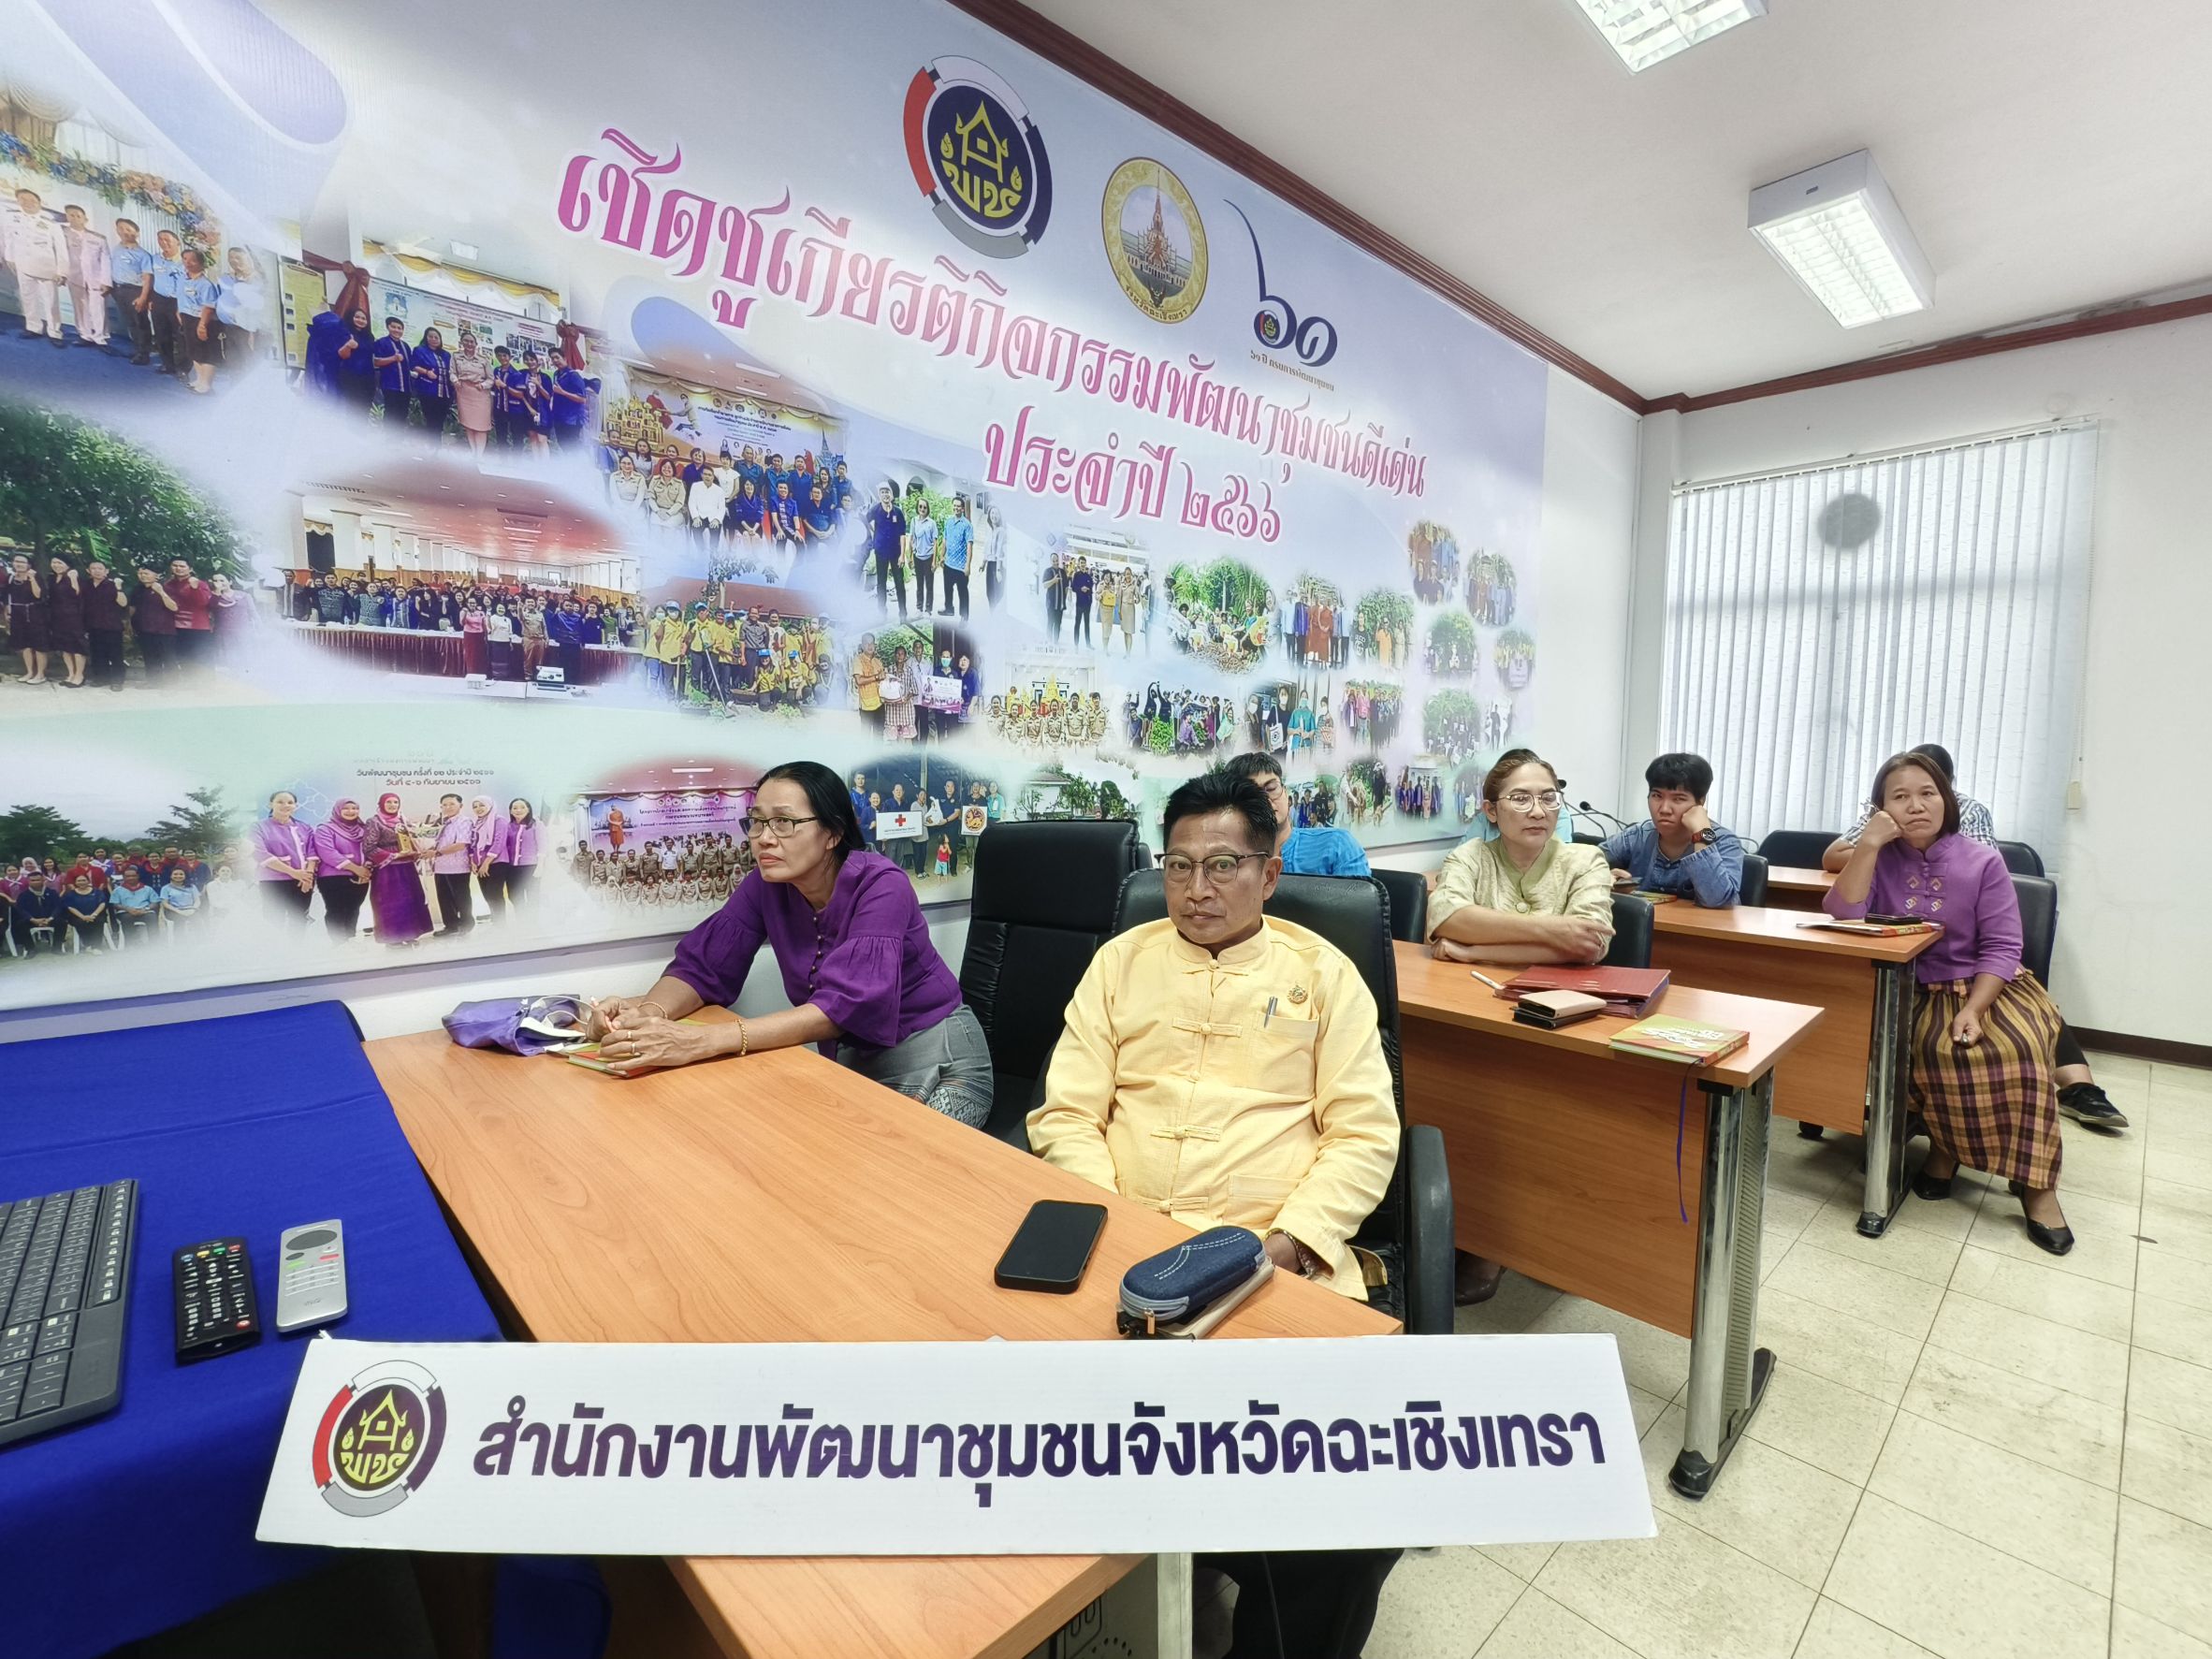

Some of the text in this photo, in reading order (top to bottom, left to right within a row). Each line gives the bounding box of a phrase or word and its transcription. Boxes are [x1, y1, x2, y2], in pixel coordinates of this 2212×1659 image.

[558, 127, 1427, 499] เชิดชูเกียรติกิจกรรมพัฒนาชุมชนดีเด่น
[985, 405, 1281, 543] ประจำปี ๒๕๖๖
[473, 1396, 1606, 1507] สำนักงานพัฒนาชุมชนจังหวัดฉะเชิงเทรา
